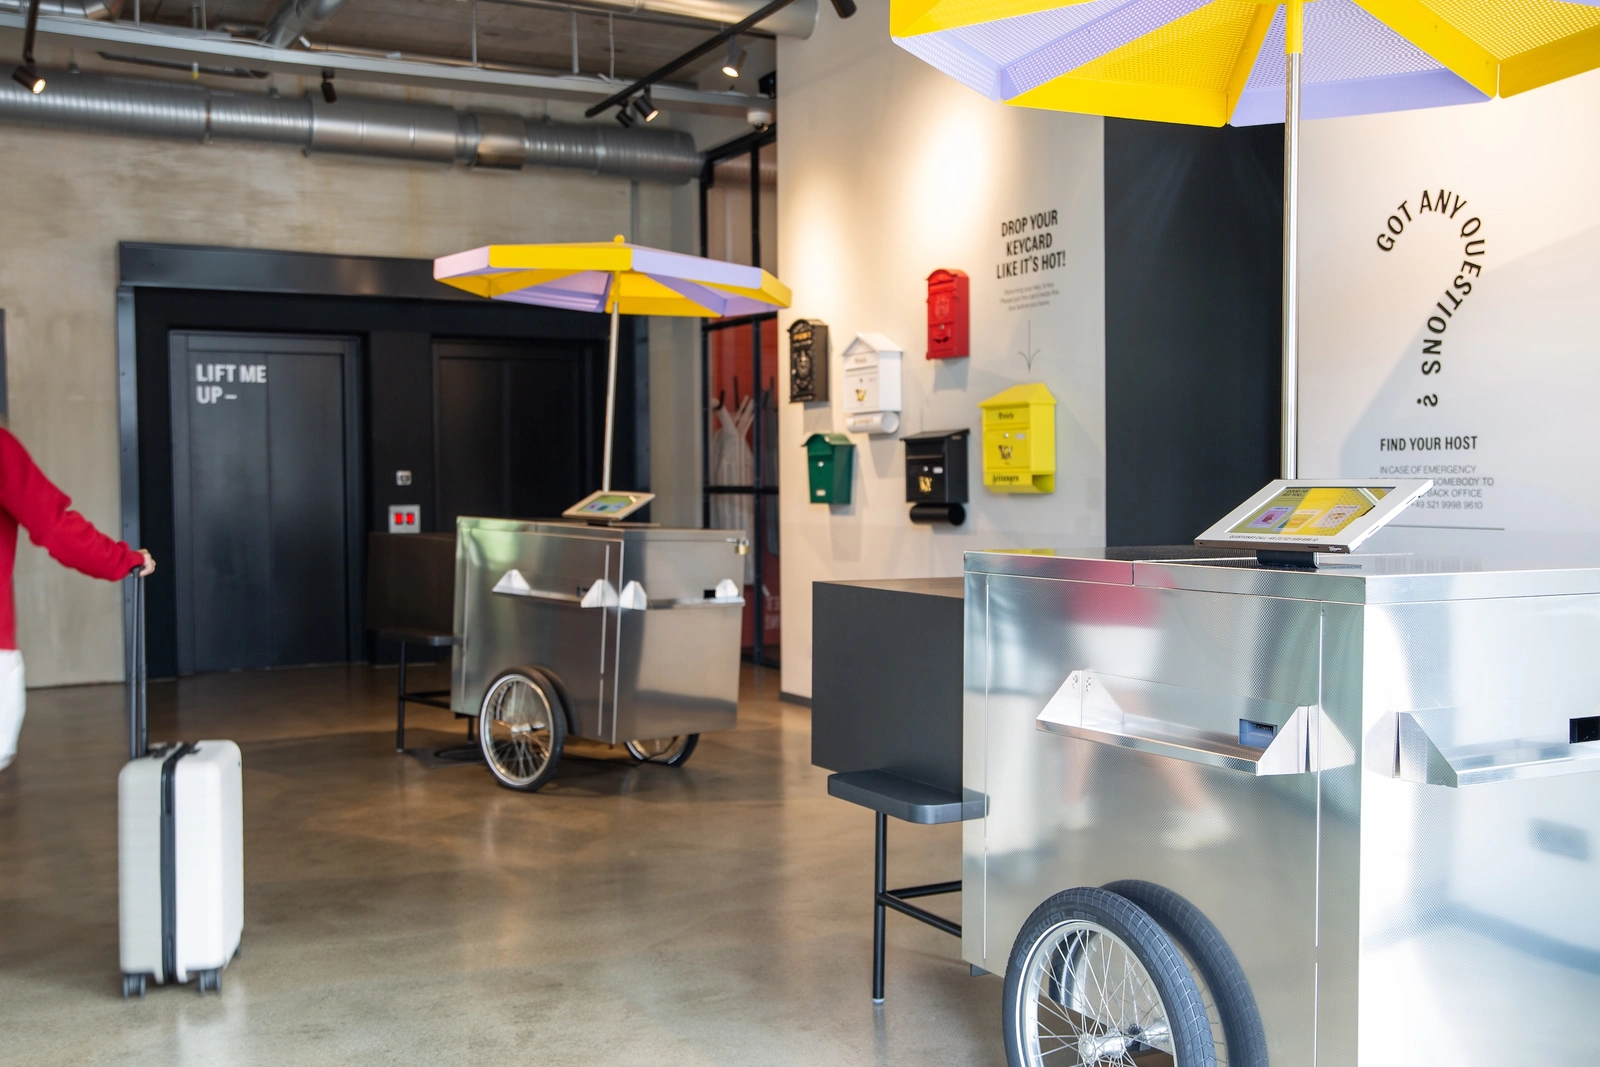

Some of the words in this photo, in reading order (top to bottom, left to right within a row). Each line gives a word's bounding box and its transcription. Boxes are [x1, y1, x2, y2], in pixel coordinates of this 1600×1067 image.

[1419, 189, 1467, 219] ANY
[1002, 217, 1028, 237] DROP
[1030, 209, 1058, 229] YOUR
[1377, 200, 1413, 252] GOT
[1006, 232, 1053, 257] KEYCARD
[997, 260, 1018, 279] LIKE
[1020, 255, 1039, 275] IT'S
[1042, 250, 1066, 270] HOT!
[1421, 217, 1486, 376] QUESTIONS
[195, 363, 237, 383] LIFT
[239, 364, 267, 384] ME
[1380, 438, 1406, 452] FIND
[1409, 437, 1441, 451] YOUR
[1445, 435, 1478, 450] HOST
[1380, 466, 1388, 475] IN
[1389, 466, 1410, 475] CASE
[1411, 466, 1422, 475] OF
[1423, 465, 1477, 475] EMERGENCY
[1432, 477, 1479, 487] SOMEBODY
[1482, 477, 1495, 486] TO
[1427, 488, 1450, 498] BACK
[1452, 488, 1482, 498] OFFICE
[1427, 501, 1439, 509] 521
[1441, 501, 1461, 509] 9998
[1463, 501, 1483, 510] 9610
[1015, 910, 1098, 970] SCHWALBE
